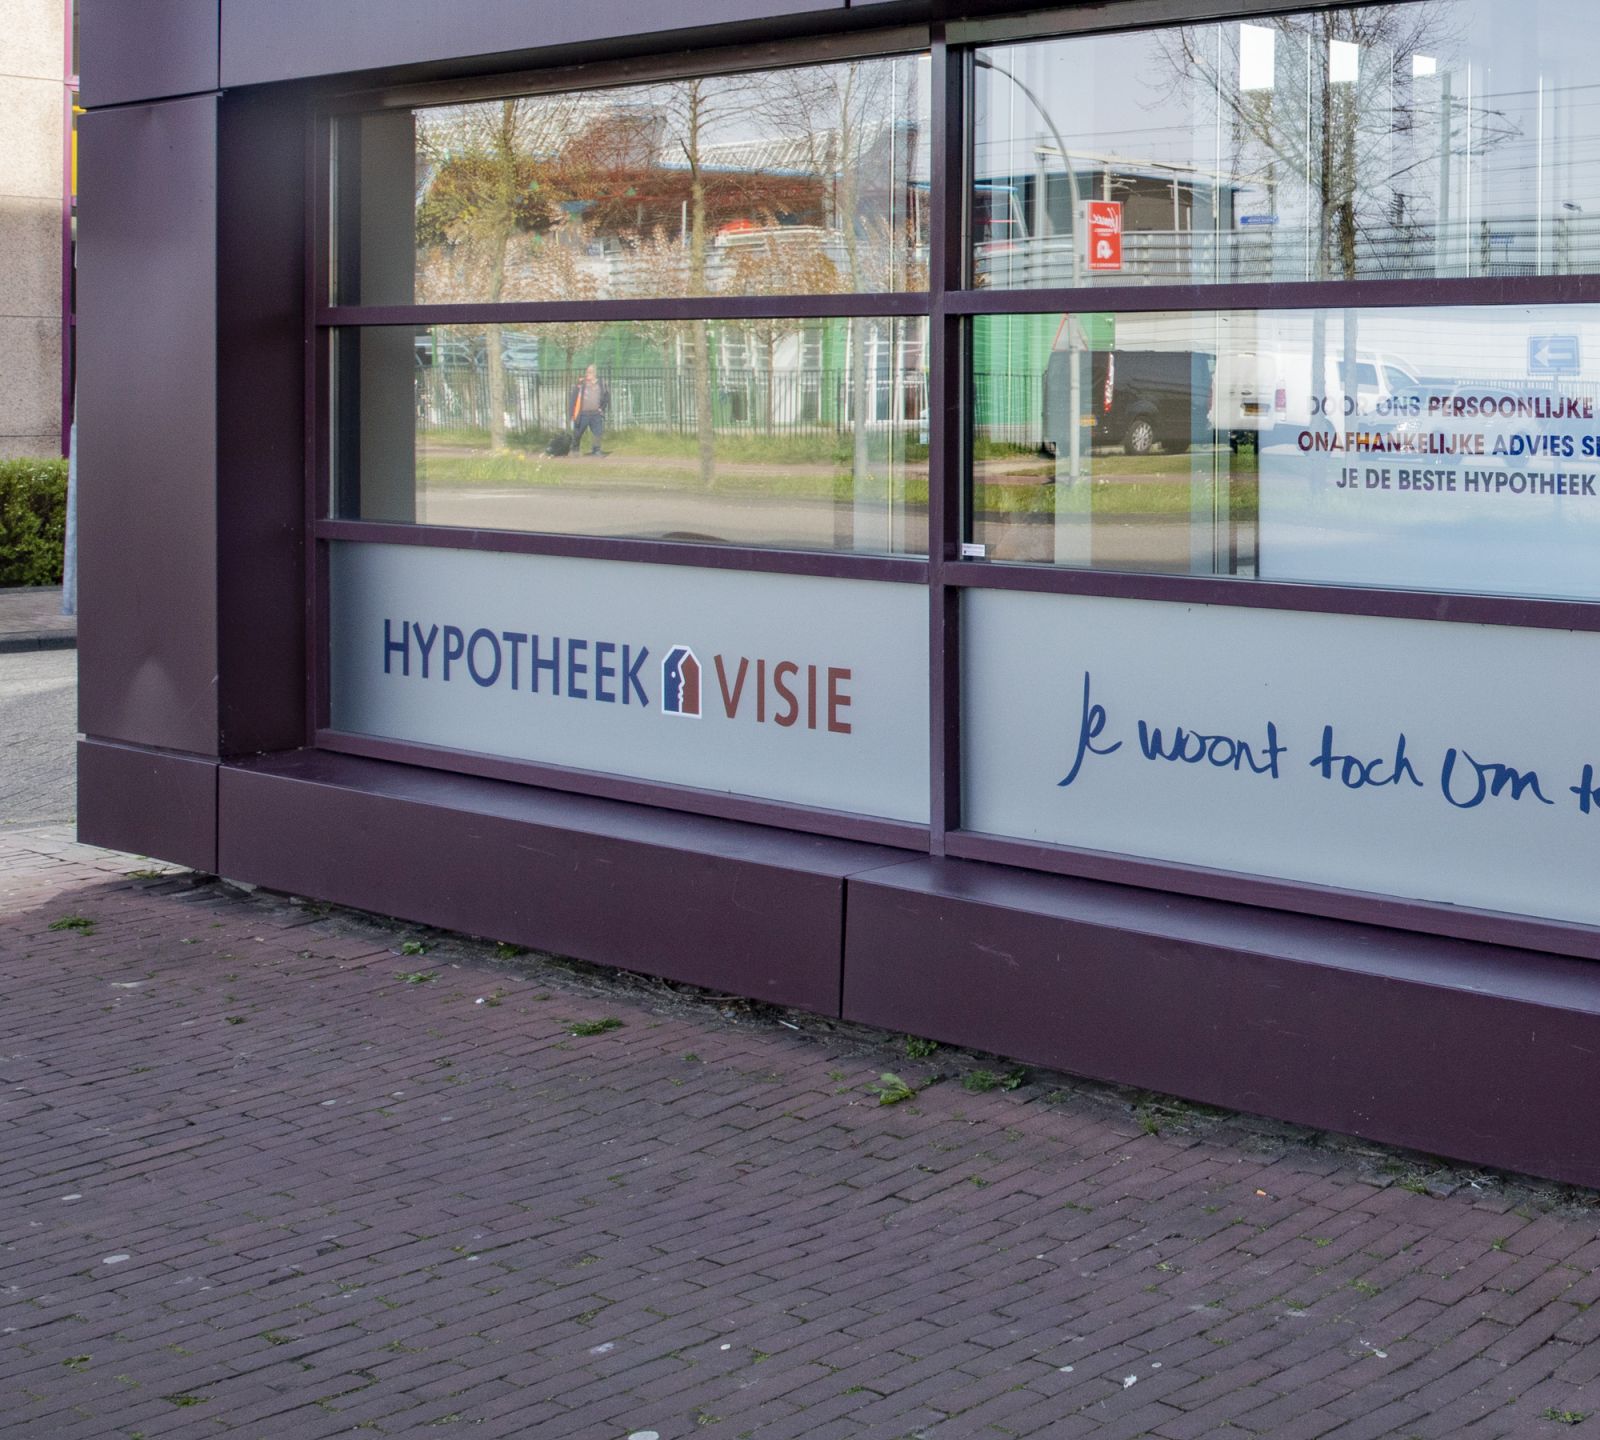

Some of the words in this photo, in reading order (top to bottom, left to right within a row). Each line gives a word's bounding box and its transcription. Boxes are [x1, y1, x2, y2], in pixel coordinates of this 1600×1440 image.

[1376, 396, 1420, 417] ONS
[1428, 396, 1593, 419] PERSOONLIJKE
[1298, 430, 1484, 455] ONAFHANKELIJKE
[1492, 434, 1574, 457] ADVIES
[1336, 468, 1358, 488] JE
[1365, 468, 1391, 489] DE
[1399, 469, 1456, 491] BESTE
[1465, 471, 1596, 496] HYPOTHEEK
[384, 618, 650, 708] HYPOTHEEK
[714, 654, 852, 735] VISIE
[1057, 671, 1122, 786] Je
[1138, 721, 1287, 779] woont
[1309, 725, 1424, 787] toch
